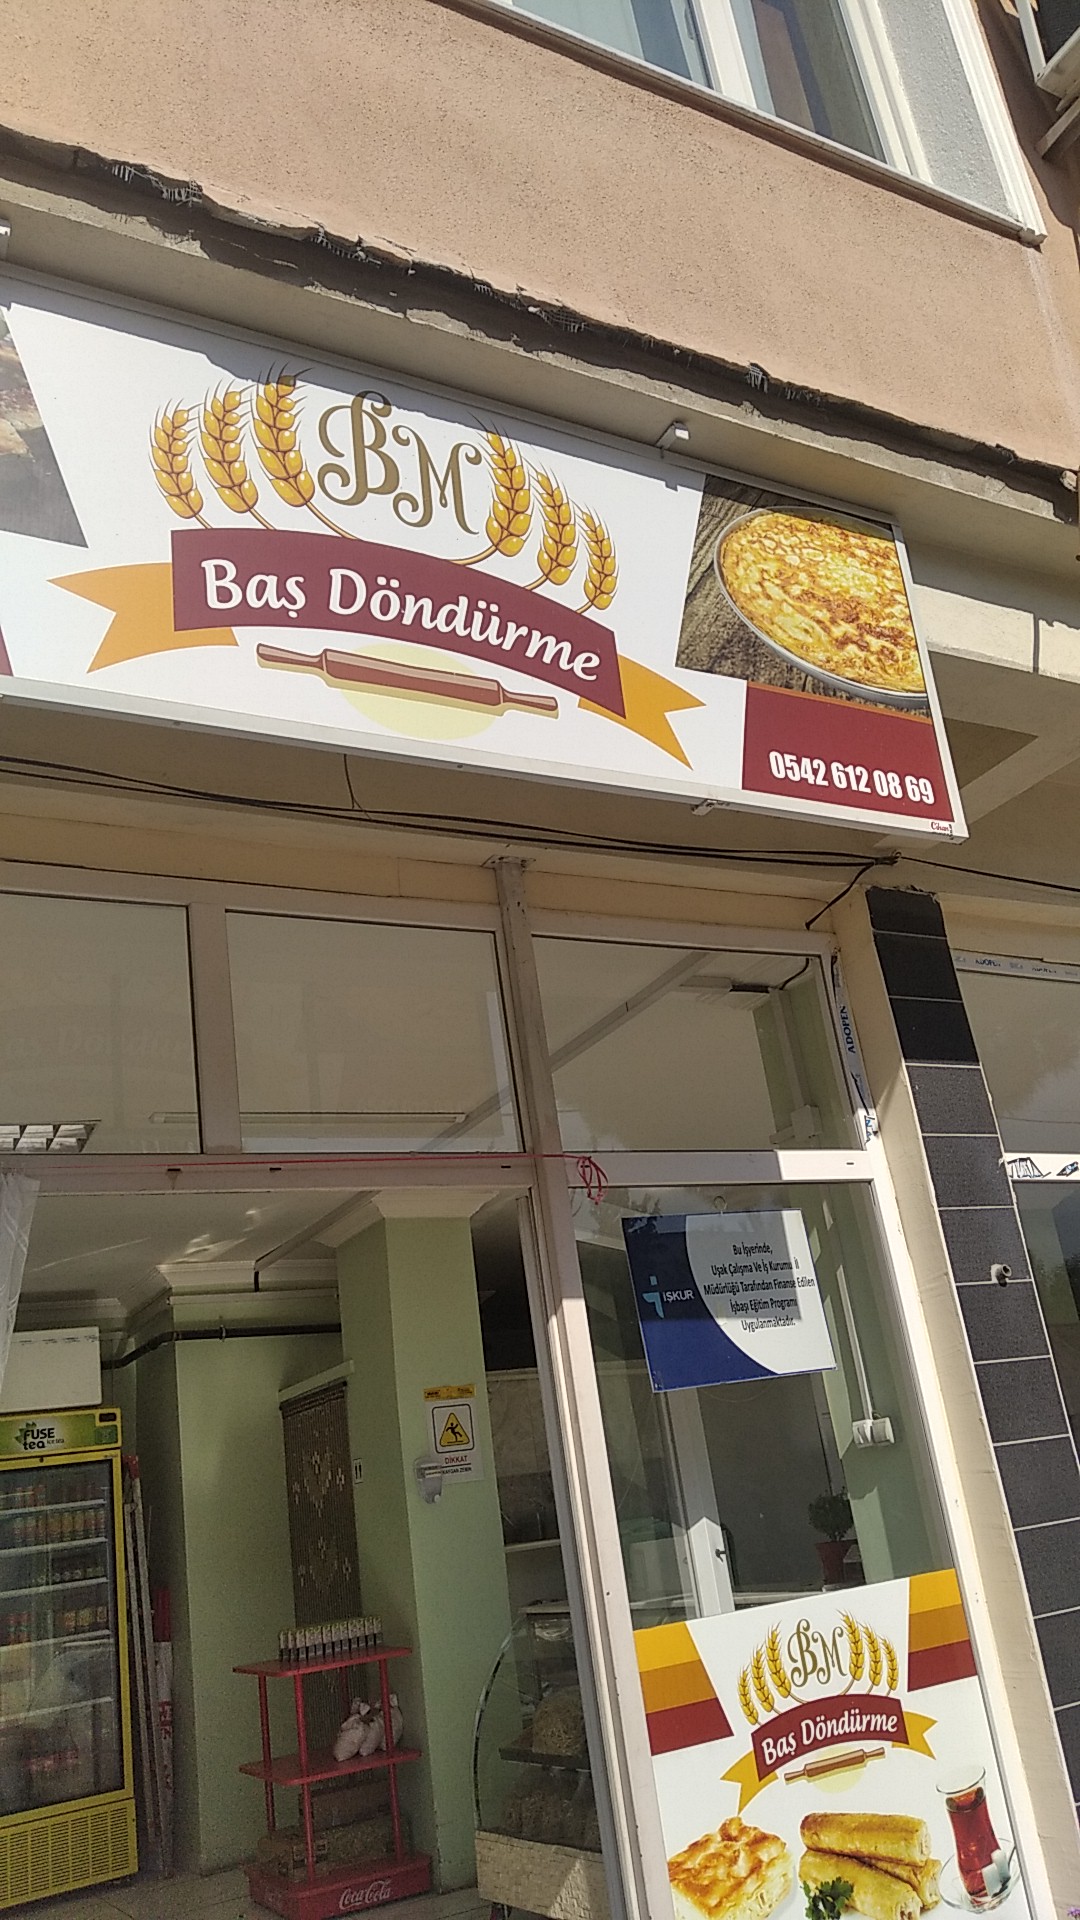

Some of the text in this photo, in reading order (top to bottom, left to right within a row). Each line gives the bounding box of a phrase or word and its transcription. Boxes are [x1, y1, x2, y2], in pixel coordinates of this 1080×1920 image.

[200, 558, 601, 682] Baş Döndürme
[768, 750, 935, 805] 0542 612 08 69
[840, 1005, 856, 1054] ADOPEN
[732, 1241, 773, 1257] Bu İşyerinde,
[711, 1264, 729, 1278] Uşak
[728, 1262, 753, 1277] Çalışma
[753, 1261, 762, 1273] Ve
[703, 1276, 816, 1295] Müdürlüğü Tarafından Finanse Edilen
[729, 1298, 750, 1315] İşbaşı
[749, 1298, 770, 1313] Eğitim
[740, 1315, 796, 1333] Uygulanmaktadır.
[24, 1427, 55, 1441] FUSE
[23, 1440, 46, 1450] tea
[444, 1455, 468, 1465] DİKKAT
[761, 1708, 898, 1765] Baş Döndürme
